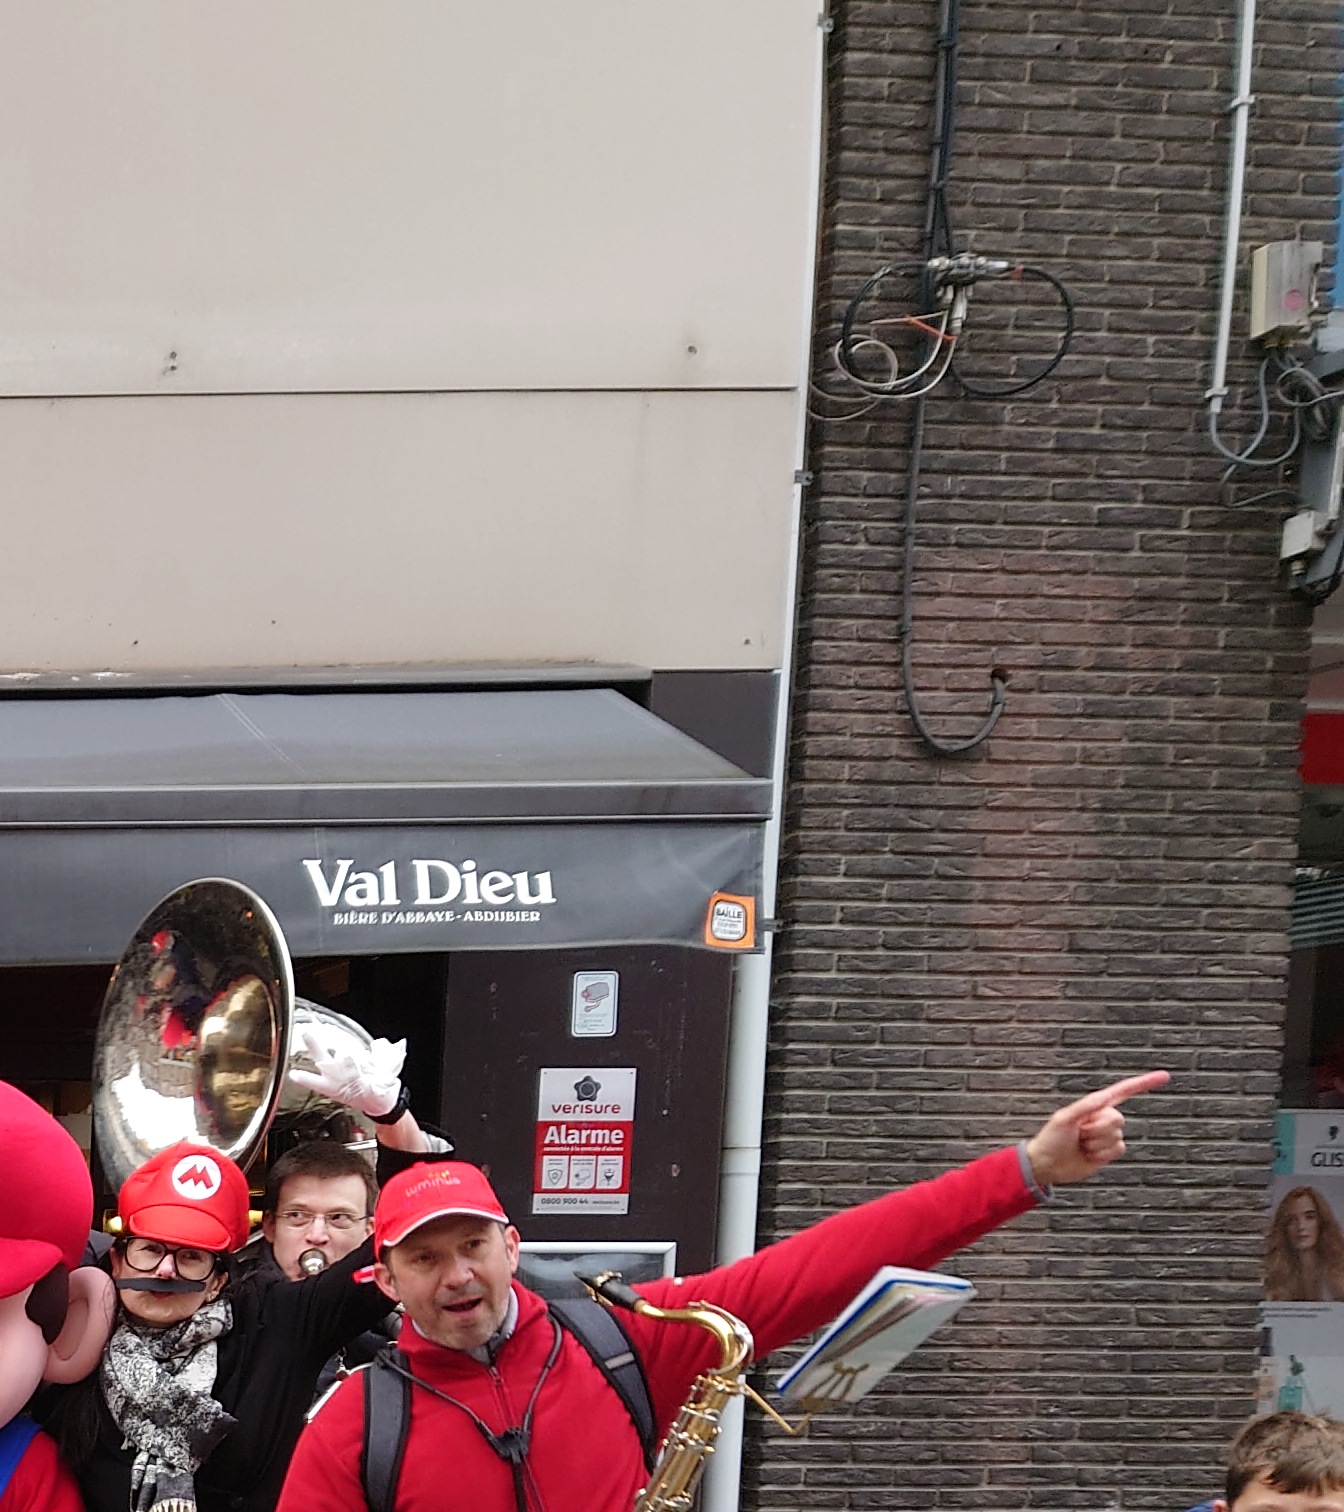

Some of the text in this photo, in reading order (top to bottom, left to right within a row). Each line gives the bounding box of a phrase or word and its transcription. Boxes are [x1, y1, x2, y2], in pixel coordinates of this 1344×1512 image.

[302, 859, 557, 907] Val Dieu
[333, 909, 379, 926] BIÈRE
[552, 1104, 621, 1114] verisure
[543, 1124, 624, 1145] Alarme
[177, 1163, 214, 1190] M
